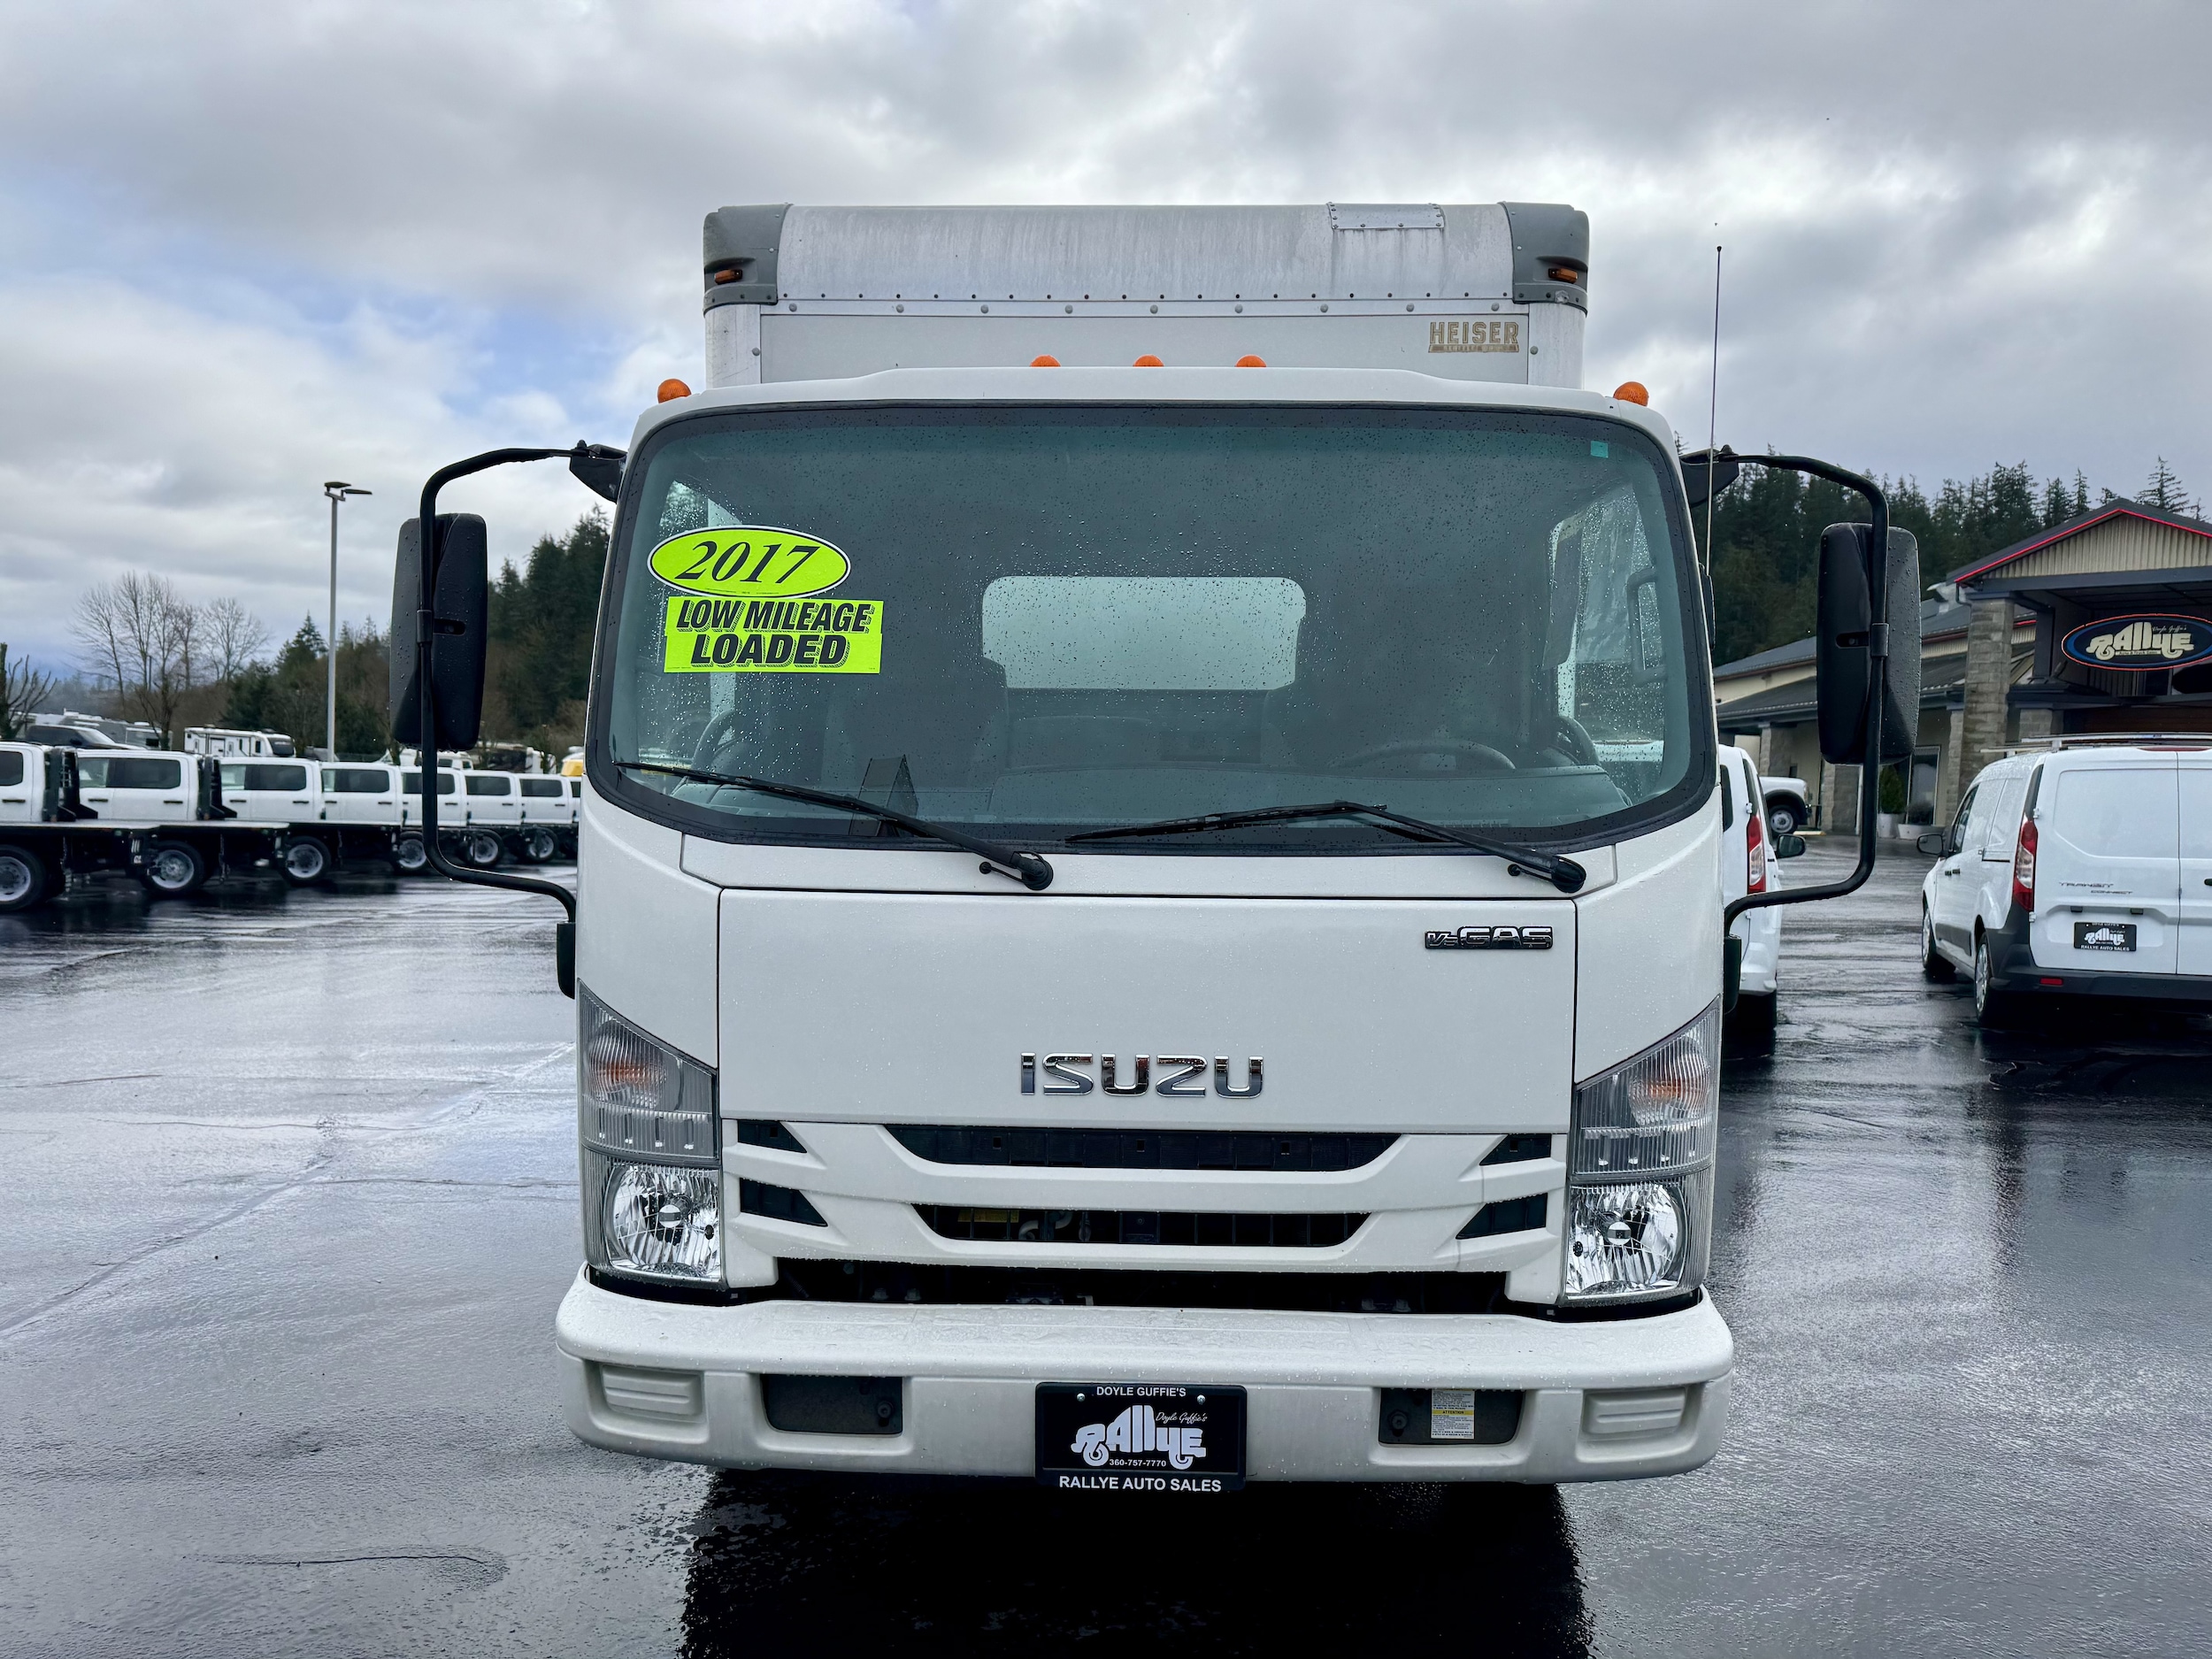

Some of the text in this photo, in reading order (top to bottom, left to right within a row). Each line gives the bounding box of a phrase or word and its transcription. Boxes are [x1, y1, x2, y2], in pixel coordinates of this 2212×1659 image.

[1430, 322, 1519, 344] HEISER
[674, 541, 821, 584] 2017
[676, 600, 875, 634] LOW MILEAGE
[690, 634, 851, 668] LOADED
[1020, 1052, 1263, 1099] ISUZU
[1096, 1386, 1187, 1398] DOYLE GUFFIE'S
[1155, 1411, 1178, 1424] Doyle
[1109, 1458, 1167, 1468] 360-757-7770
[1059, 1475, 1222, 1493] RALLYE AUTO SALES
